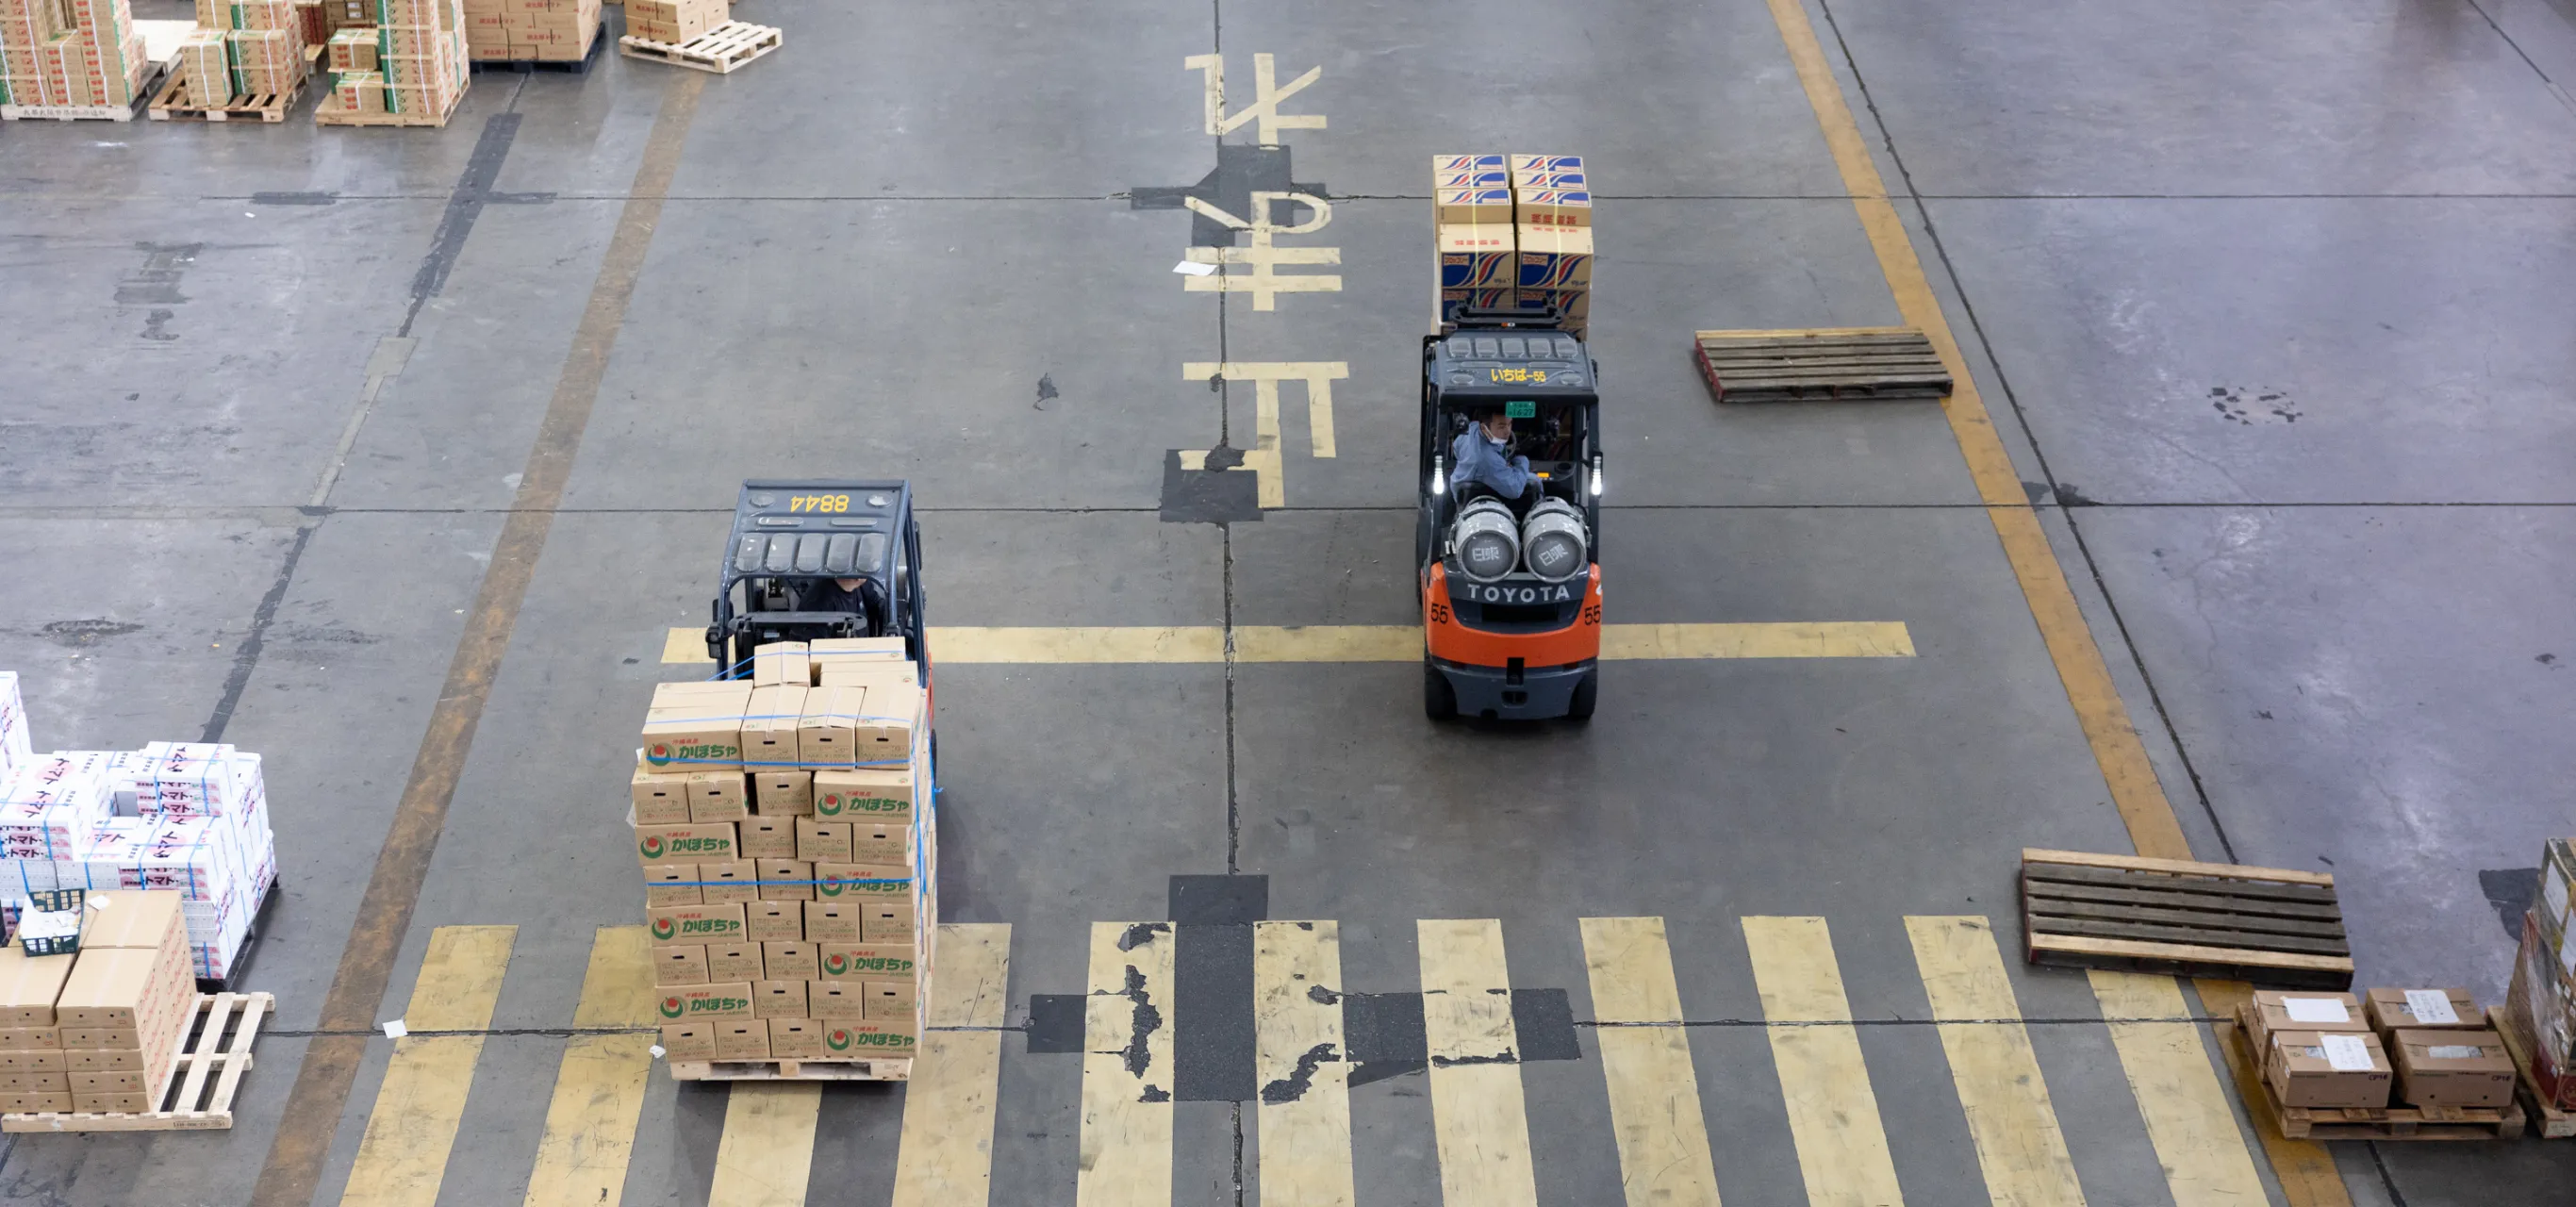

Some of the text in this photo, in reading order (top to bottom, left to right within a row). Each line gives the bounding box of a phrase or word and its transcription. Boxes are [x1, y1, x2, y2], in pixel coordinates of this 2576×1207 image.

[1179, 52, 1349, 508] 止まれ
[790, 494, 850, 513] 8844
[1467, 583, 1570, 604] TOYOTA
[1430, 604, 1448, 624] 55
[1584, 604, 1601, 625] 55
[679, 744, 737, 759] かぼちゃ
[849, 797, 910, 812] かぼちゃ
[670, 836, 731, 852] かぼちゃ
[682, 918, 740, 934] かぼちゃ
[854, 957, 914, 971] かぼちゃ
[690, 998, 749, 1012] かぼちゃ
[857, 1033, 916, 1047] かぼちゃ
